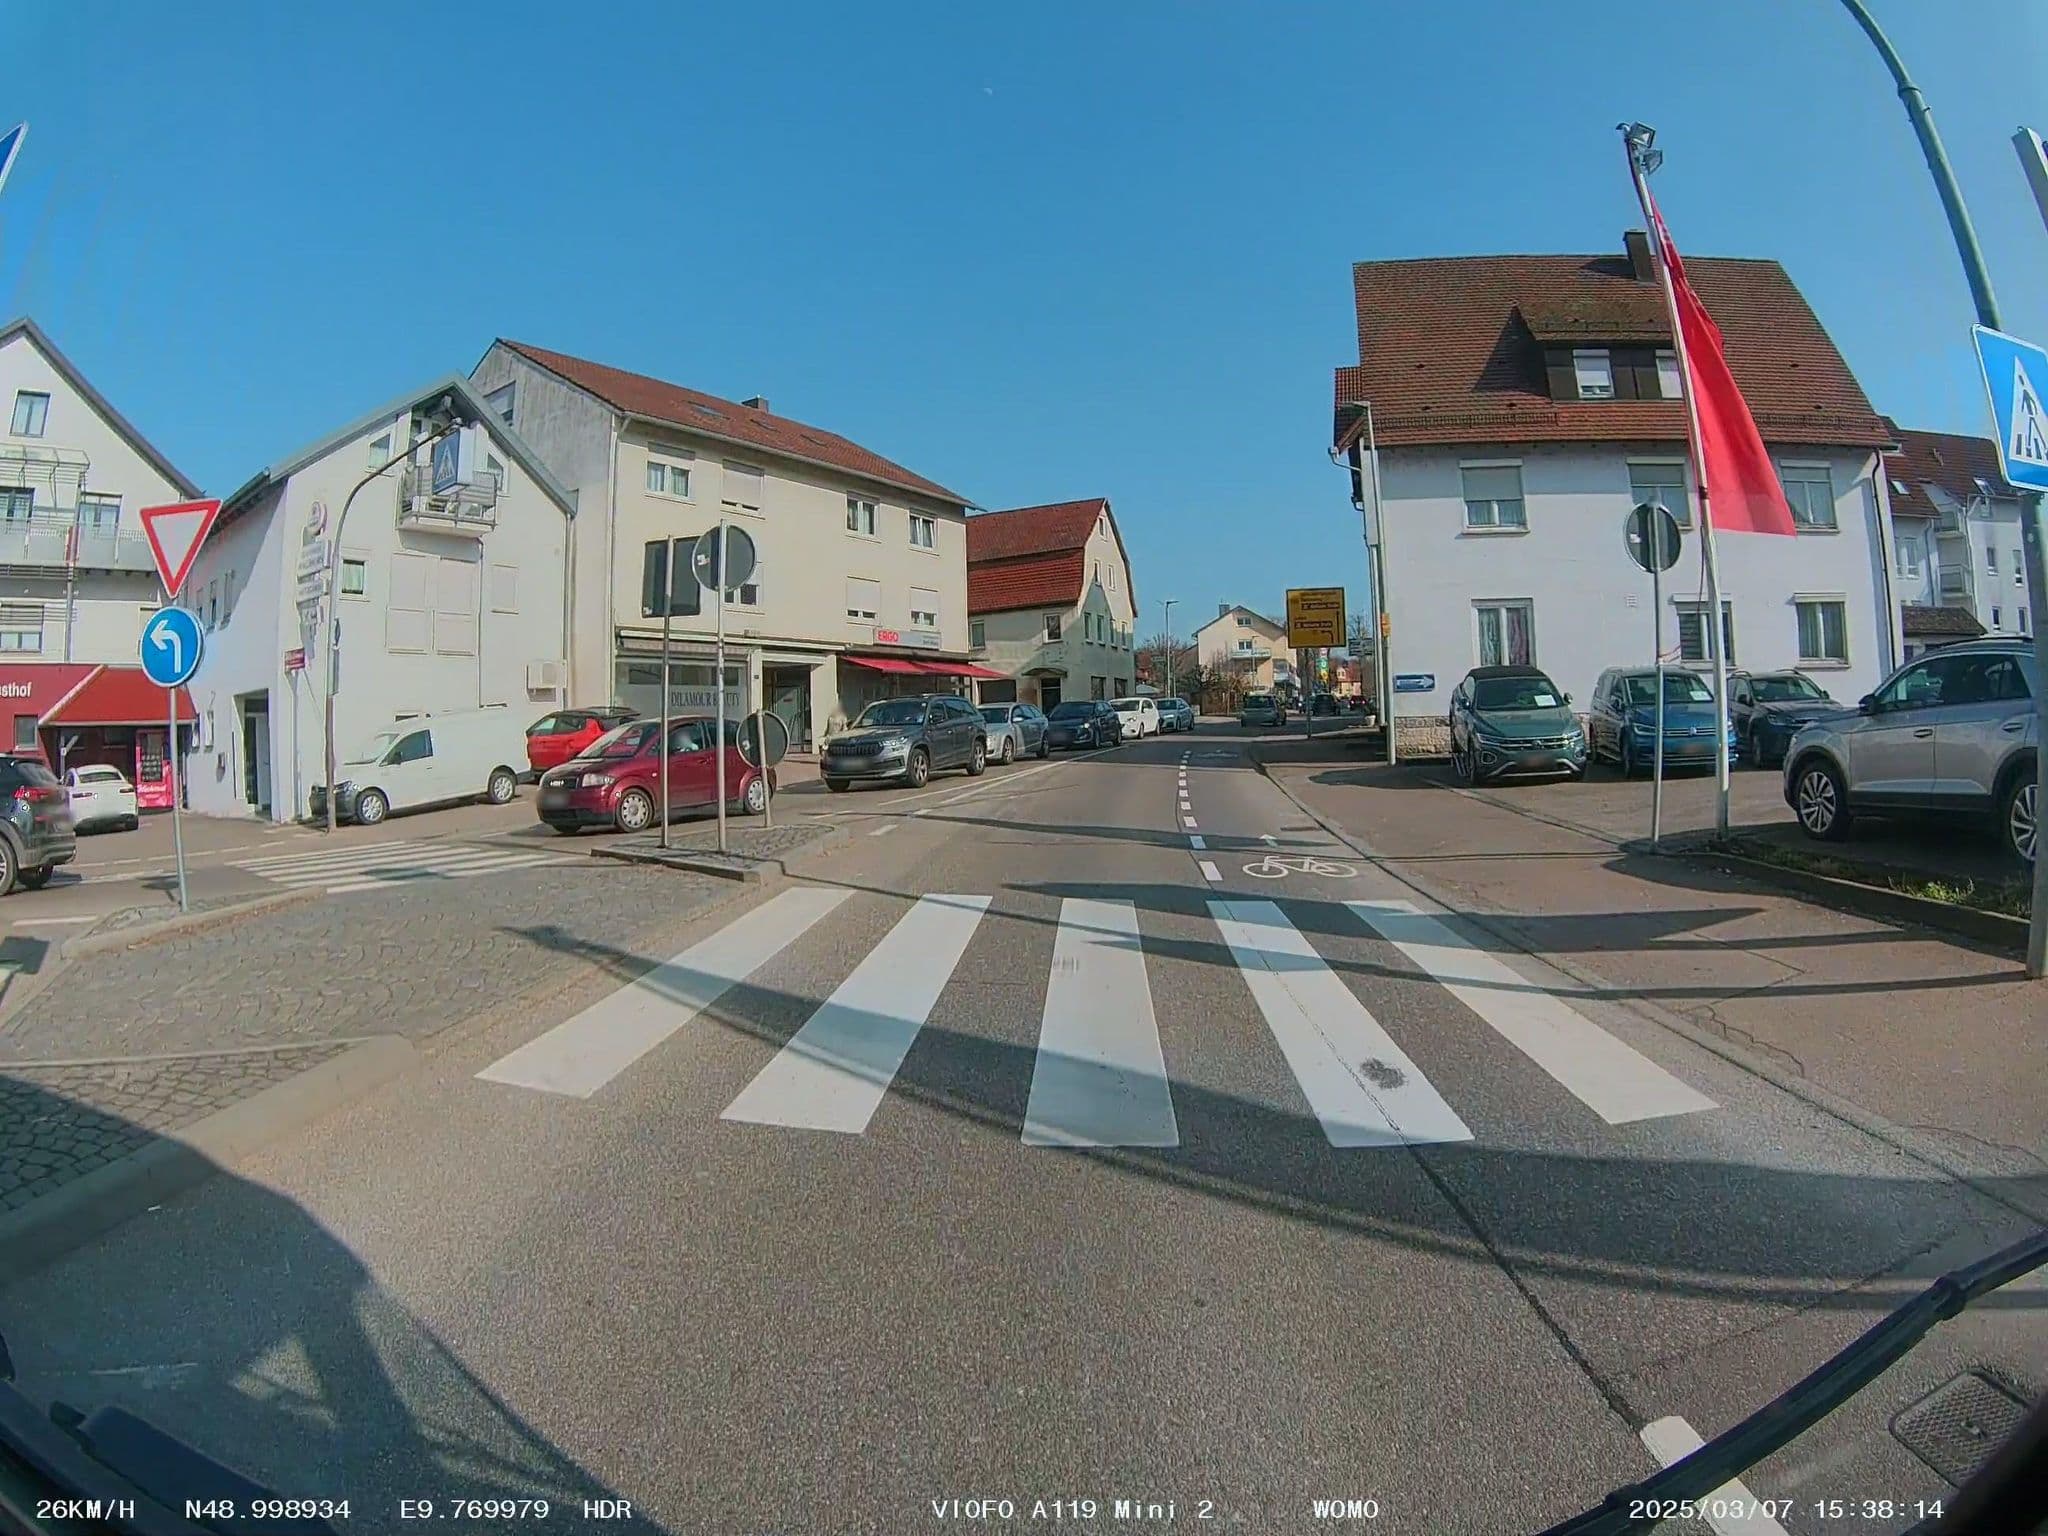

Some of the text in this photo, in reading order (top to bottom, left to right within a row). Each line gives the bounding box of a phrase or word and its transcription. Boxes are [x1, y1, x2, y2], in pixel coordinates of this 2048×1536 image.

[878, 630, 899, 642] ERGO
[0, 681, 32, 698] sthof
[712, 692, 740, 706] BUTY
